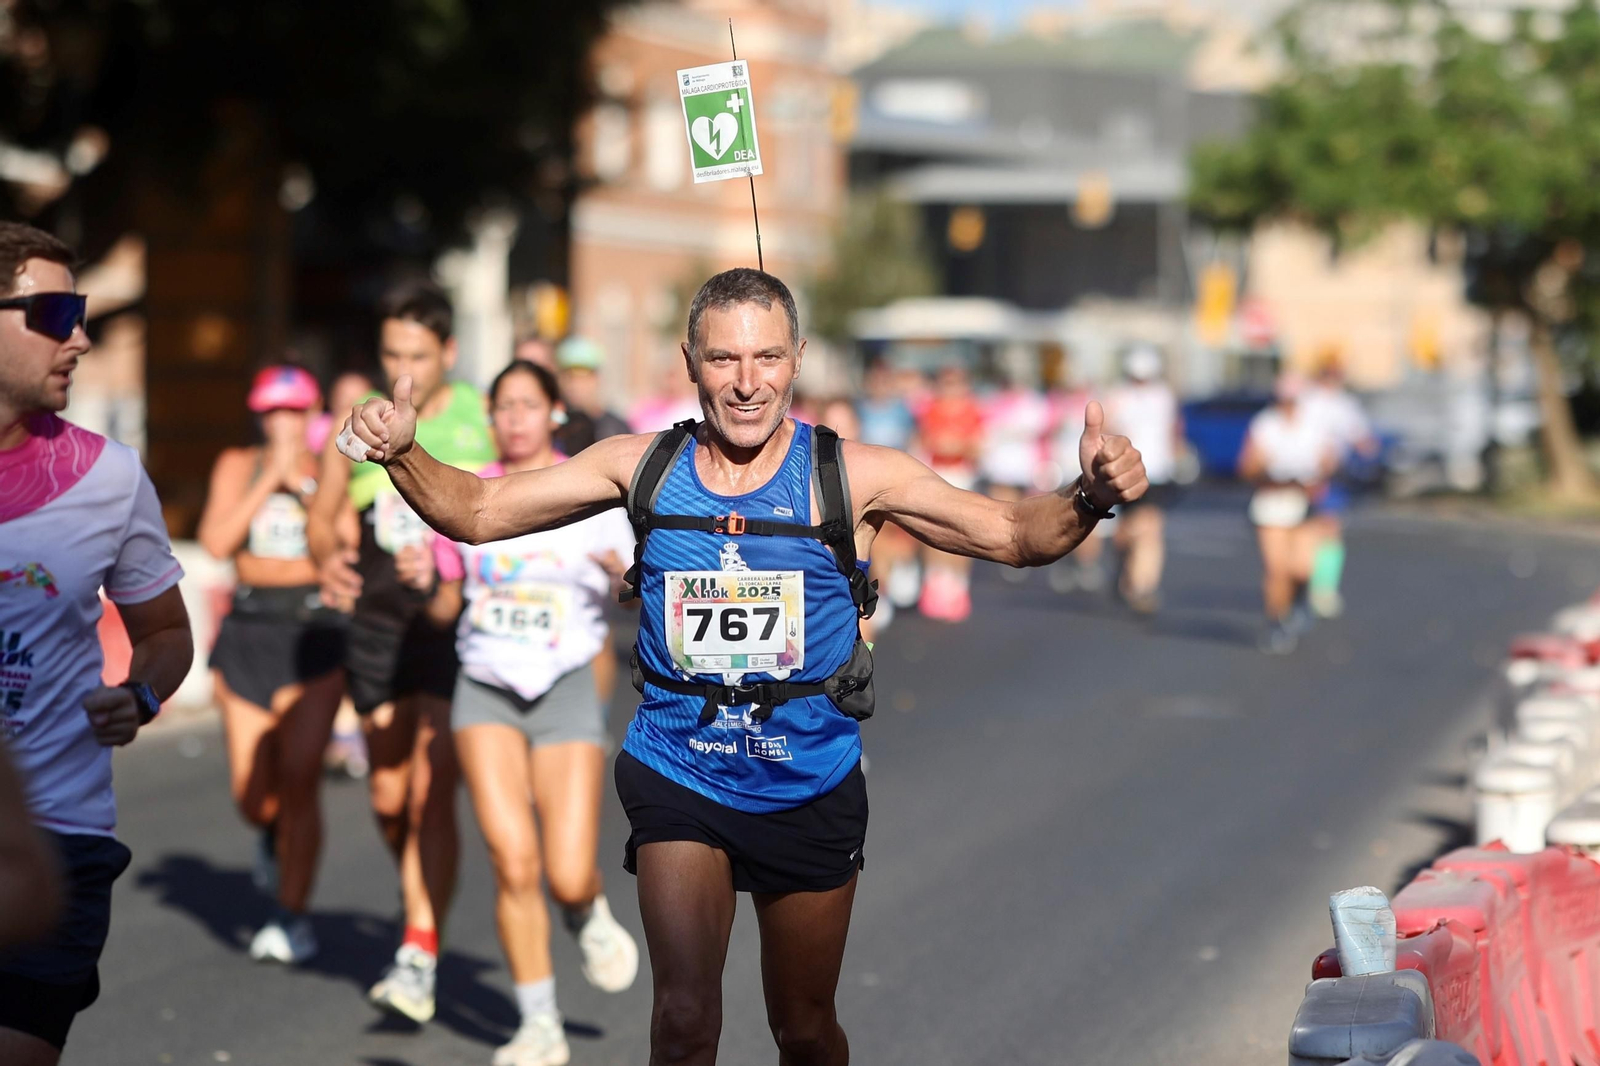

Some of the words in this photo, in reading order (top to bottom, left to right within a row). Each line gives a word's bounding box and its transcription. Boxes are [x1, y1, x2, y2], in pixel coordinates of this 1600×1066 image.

[701, 80, 747, 92] CARDIOPROTEGIDA
[734, 149, 755, 160] DEA
[737, 586, 781, 597] 2025
[492, 606, 550, 629] 164
[687, 607, 780, 642] 767
[689, 738, 737, 754] mayoral
